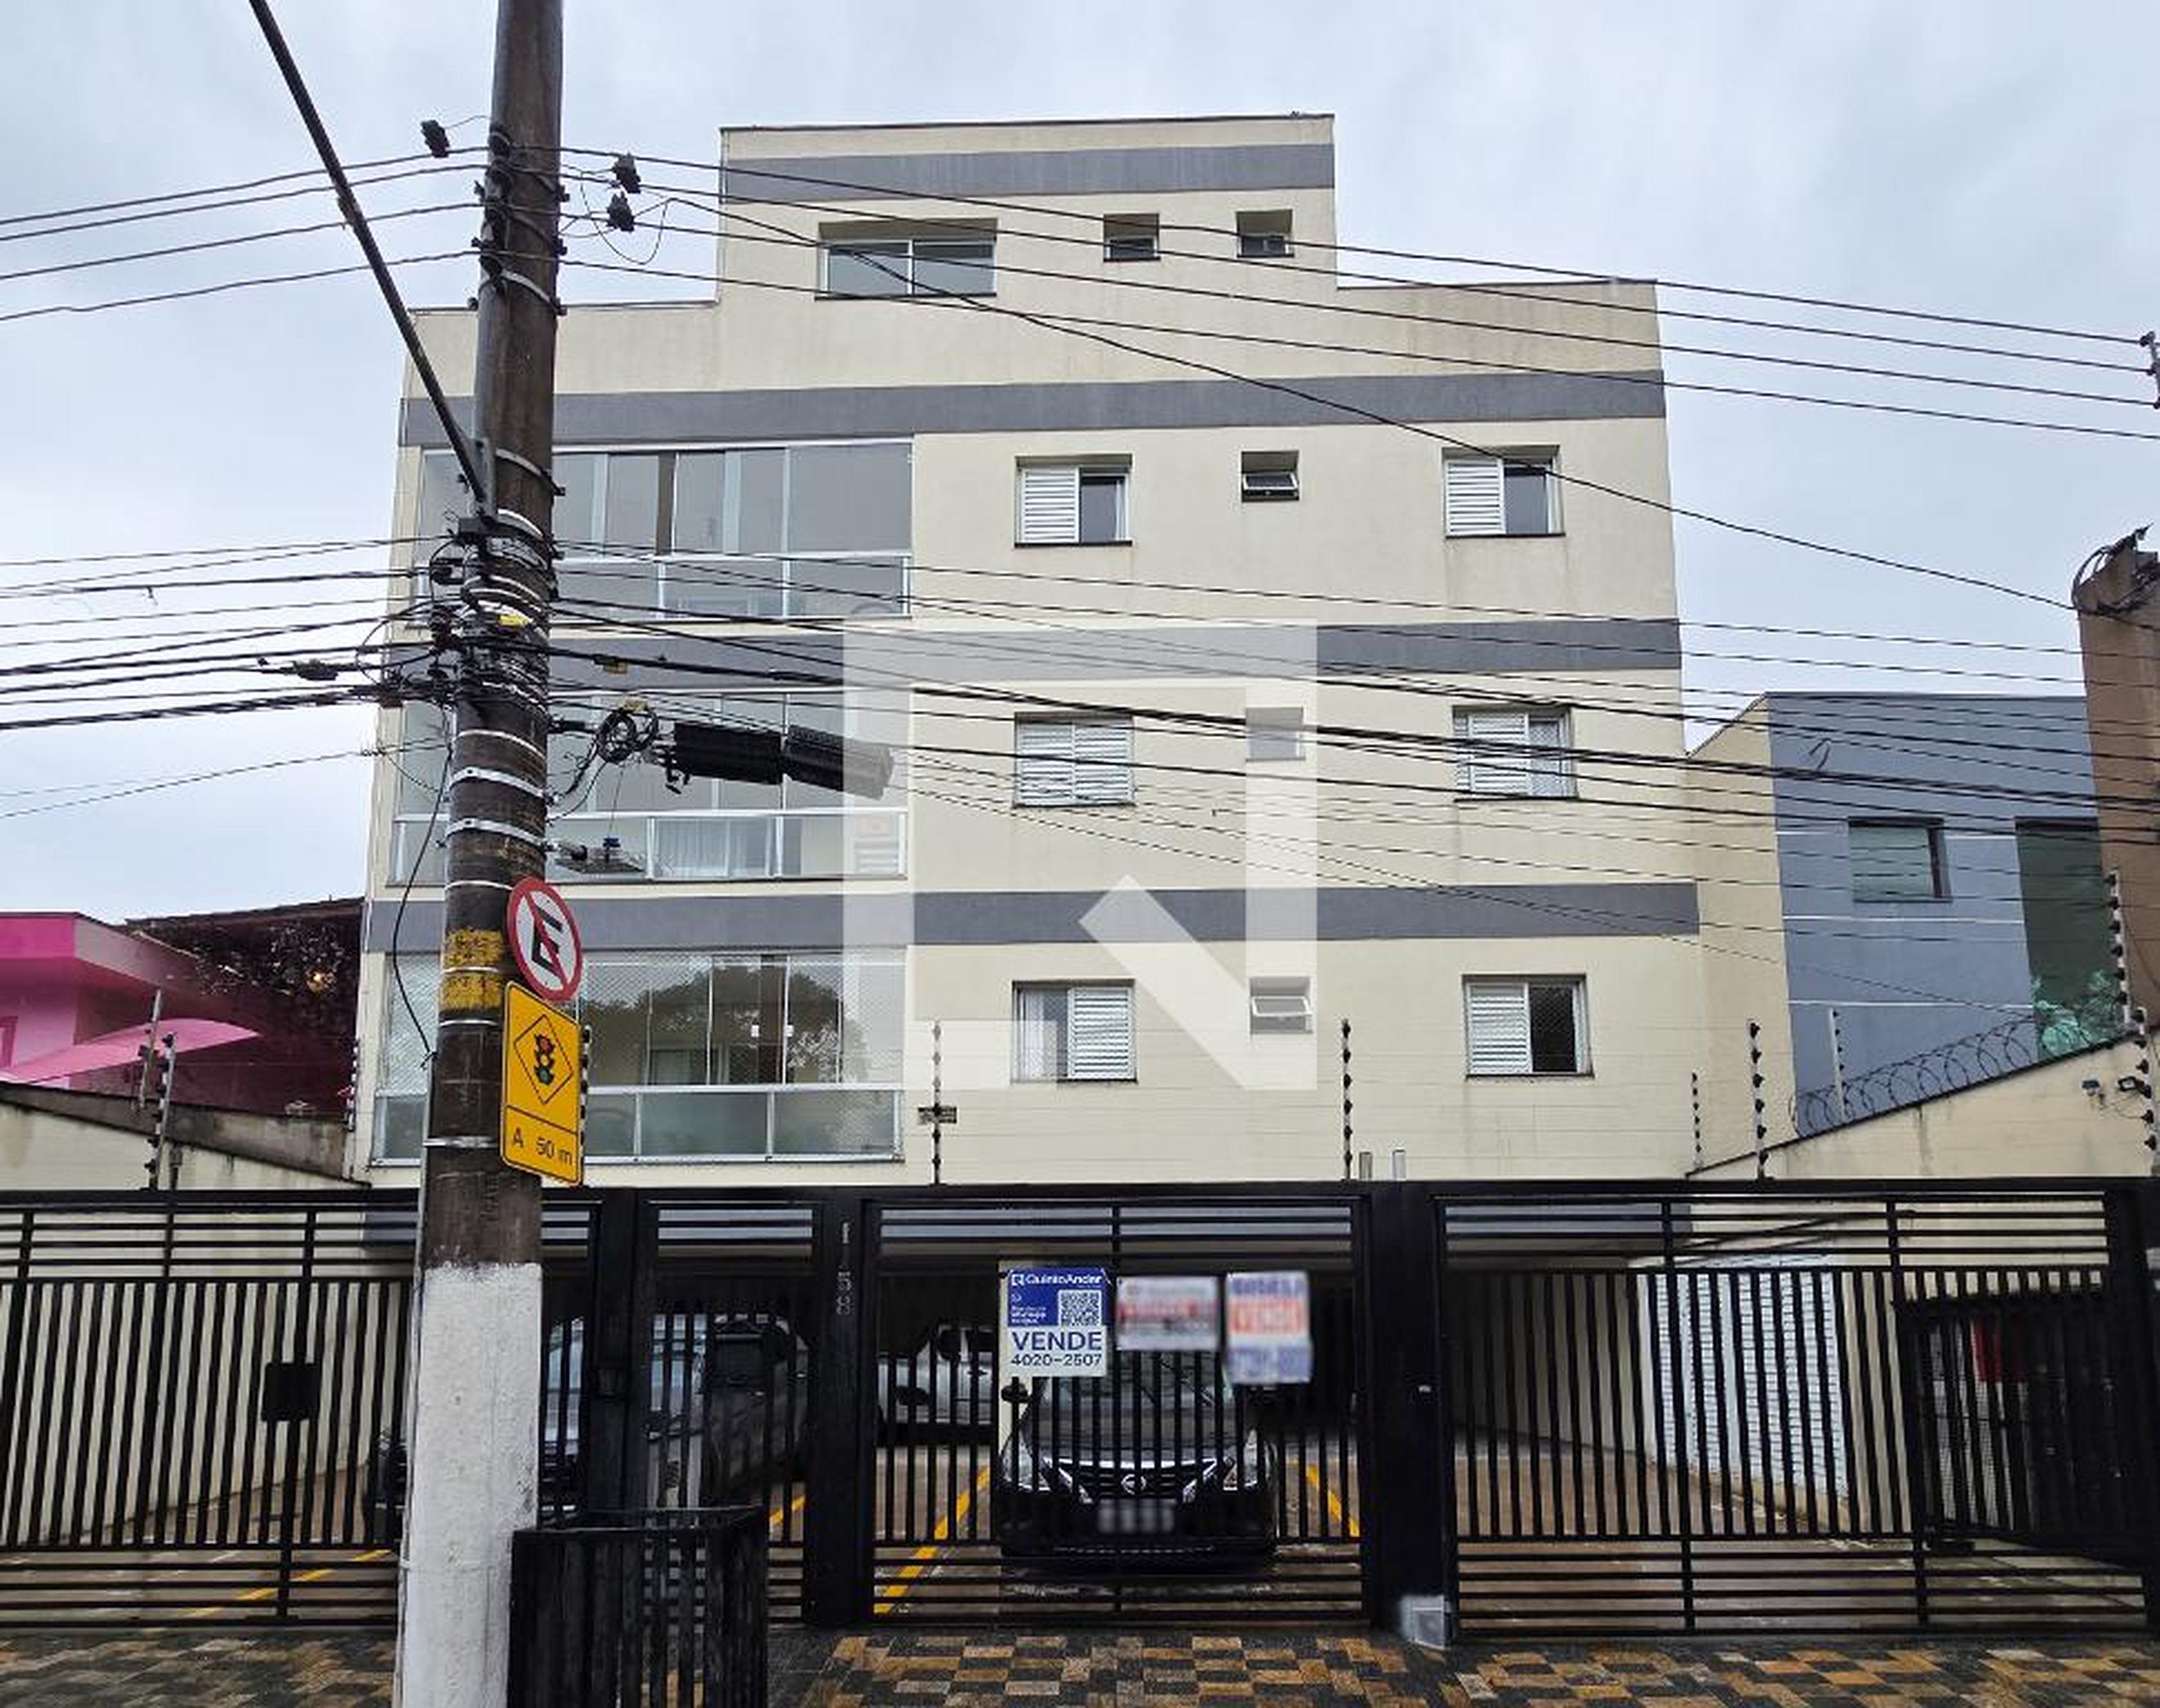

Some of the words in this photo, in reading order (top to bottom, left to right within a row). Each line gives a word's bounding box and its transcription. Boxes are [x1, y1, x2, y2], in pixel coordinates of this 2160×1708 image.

[531, 905, 564, 979] E
[511, 1127, 524, 1148] A
[536, 1135, 555, 1159] 50
[559, 1148, 573, 1166] m
[1025, 1274, 1102, 1285] QuintoAndar
[1011, 1331, 1102, 1351] VENDE
[1011, 1353, 1102, 1367] 4020-2507
